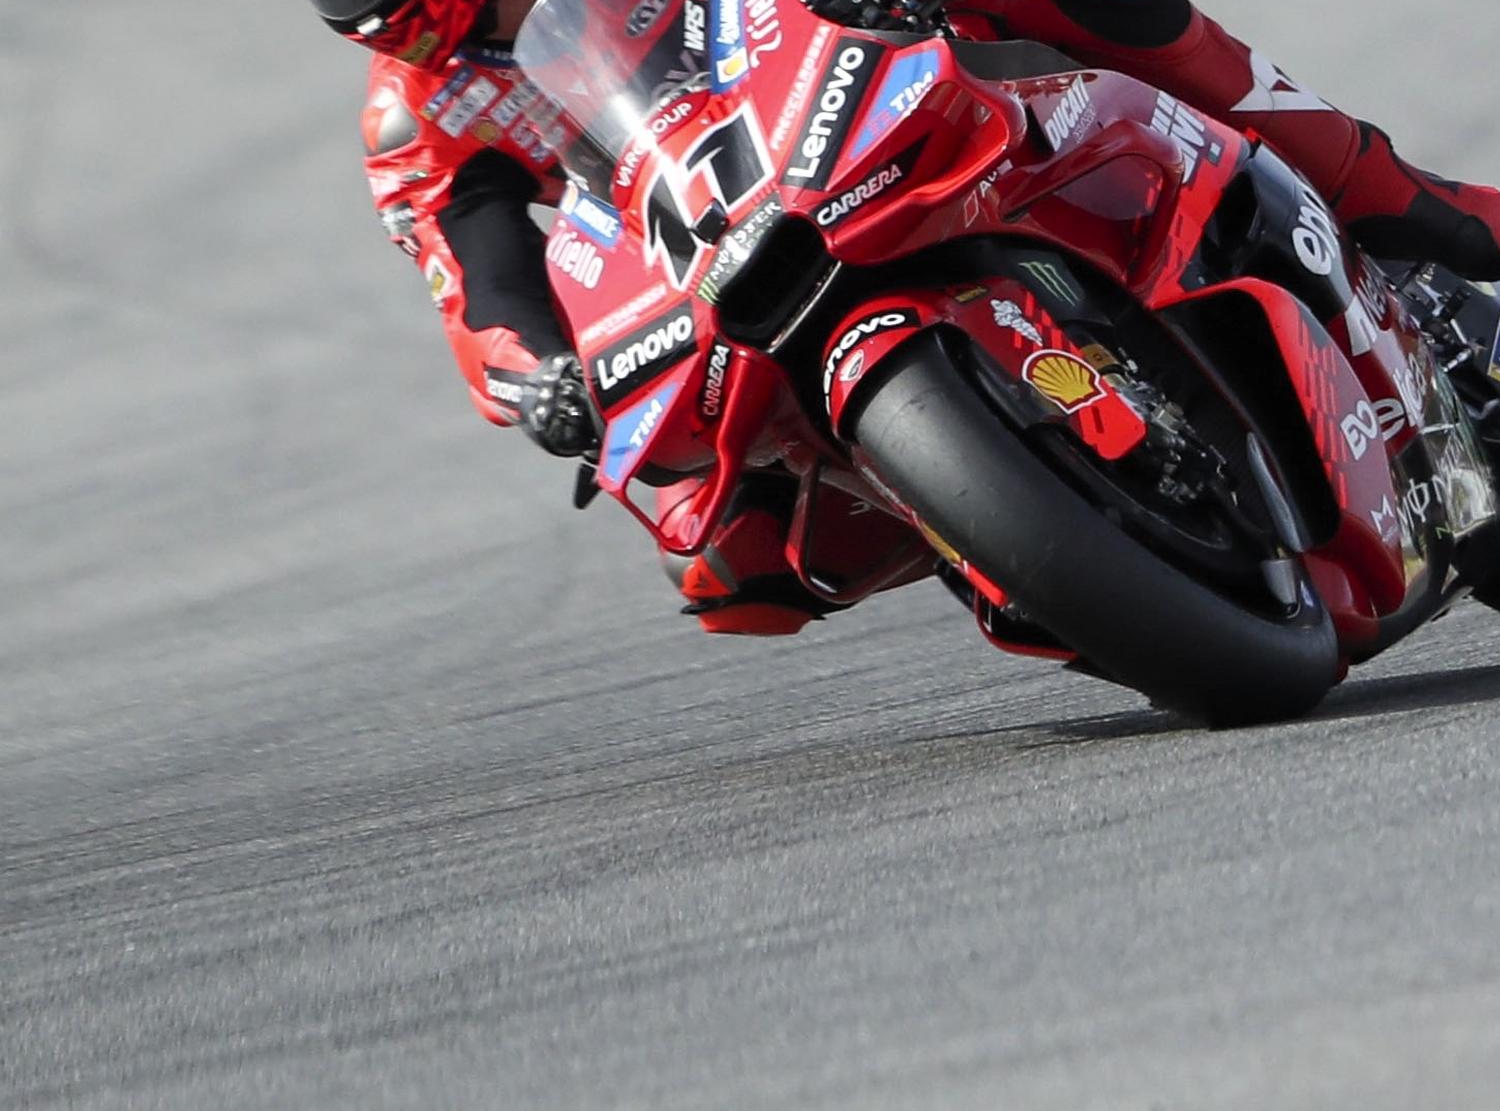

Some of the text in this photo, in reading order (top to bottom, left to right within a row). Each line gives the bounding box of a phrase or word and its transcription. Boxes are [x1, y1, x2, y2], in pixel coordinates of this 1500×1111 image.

[787, 45, 866, 179] Lenovo
[888, 71, 936, 119] TIM
[1044, 73, 1092, 152] DUCATI
[815, 163, 902, 228] CARRERA
[596, 315, 694, 391] Lenovo
[703, 343, 732, 417] CARRERA
[629, 397, 664, 449] TIM
